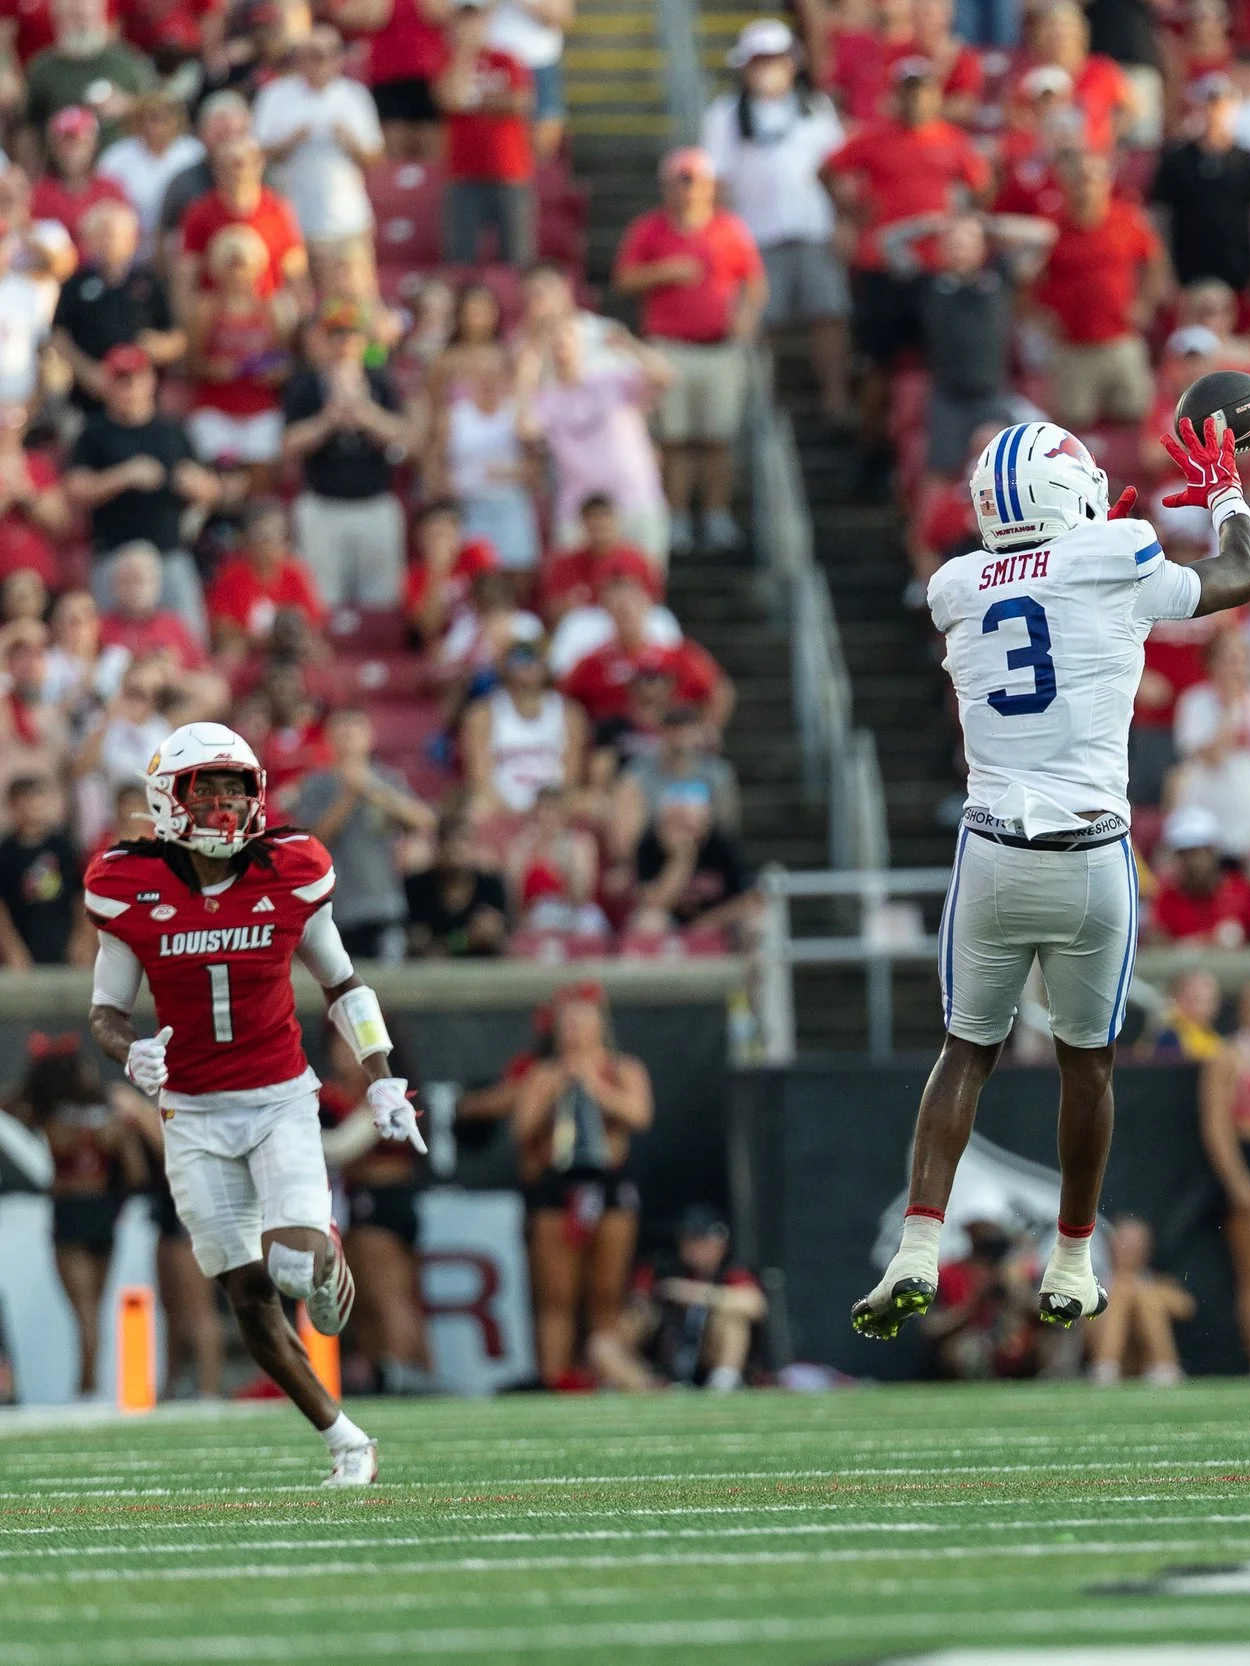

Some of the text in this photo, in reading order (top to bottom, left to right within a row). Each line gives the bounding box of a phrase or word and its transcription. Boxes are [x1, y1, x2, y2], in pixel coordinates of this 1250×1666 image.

[995, 525, 1036, 537] MUSTANGS
[978, 550, 1051, 591] SMITH
[982, 595, 1058, 717] 3
[159, 924, 275, 956] LOUISVILLE
[205, 963, 233, 1042] 1
